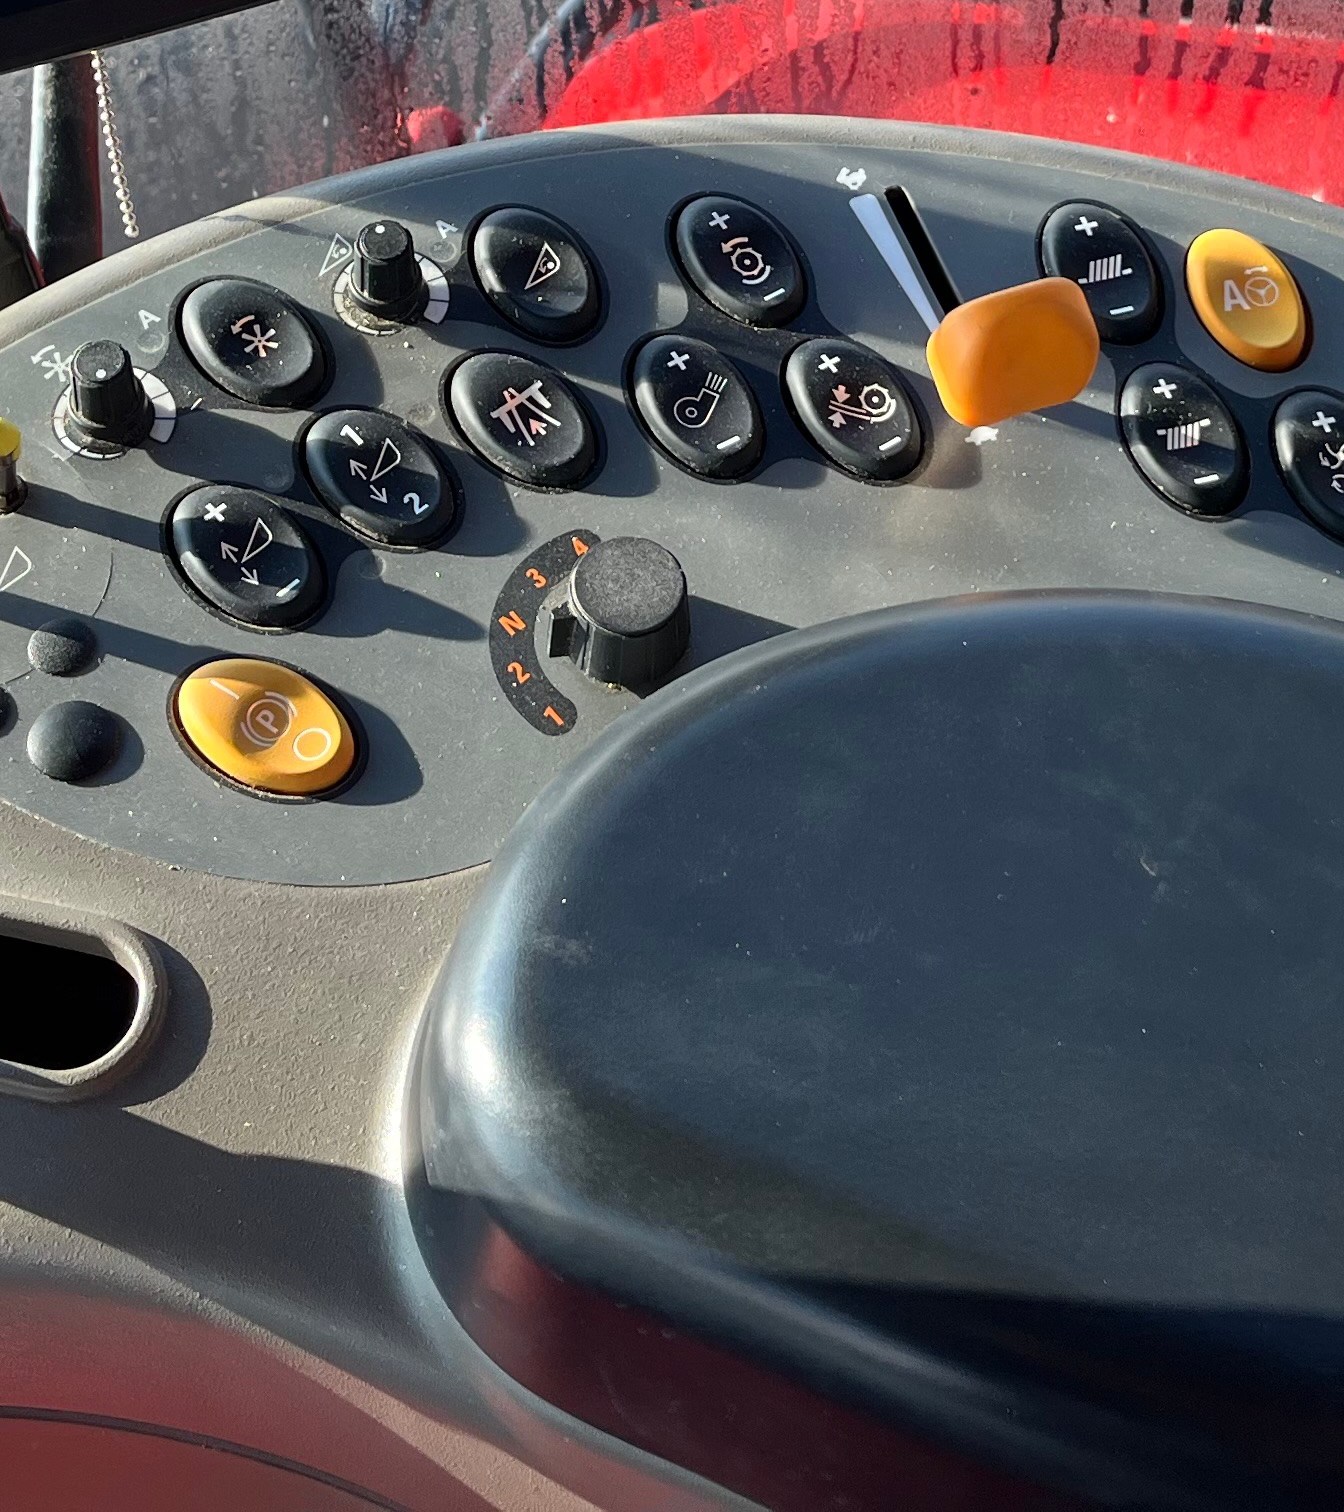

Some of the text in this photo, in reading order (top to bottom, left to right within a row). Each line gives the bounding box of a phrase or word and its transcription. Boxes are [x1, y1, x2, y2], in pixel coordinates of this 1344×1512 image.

[435, 219, 458, 239] A
[1223, 279, 1252, 312] A
[138, 309, 162, 330] A
[340, 424, 365, 447] 1
[403, 491, 430, 516] 2
[571, 536, 589, 557] 4
[525, 567, 547, 589] 3
[498, 610, 527, 637] N
[507, 661, 531, 685] 2
[255, 709, 280, 735] P
[543, 705, 565, 727] 1
